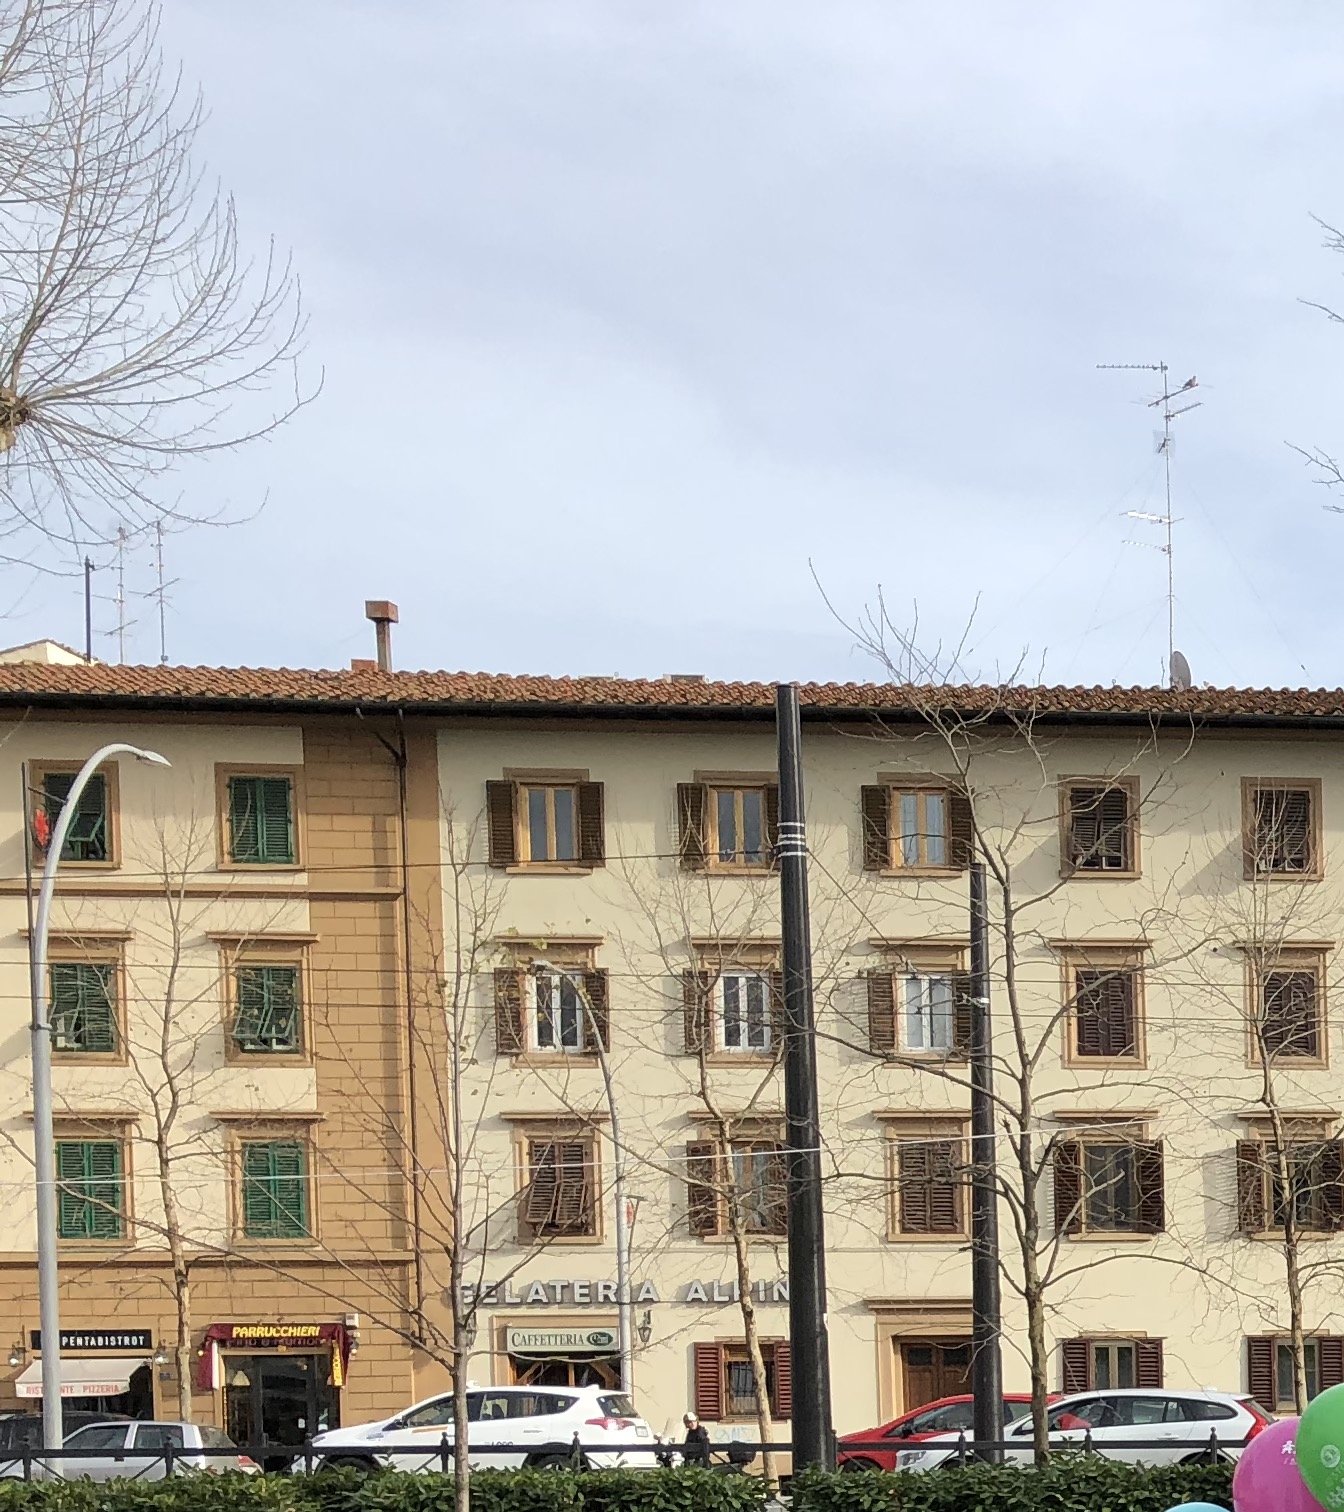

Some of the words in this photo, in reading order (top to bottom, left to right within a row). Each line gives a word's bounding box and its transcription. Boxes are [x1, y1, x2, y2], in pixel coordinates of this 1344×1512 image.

[460, 1279, 660, 1303] GELATERA
[232, 1325, 321, 1338] PARRUCCHIERI
[511, 1332, 585, 1347] CAFFETTERIA
[82, 1383, 120, 1394] PIZZERIA
